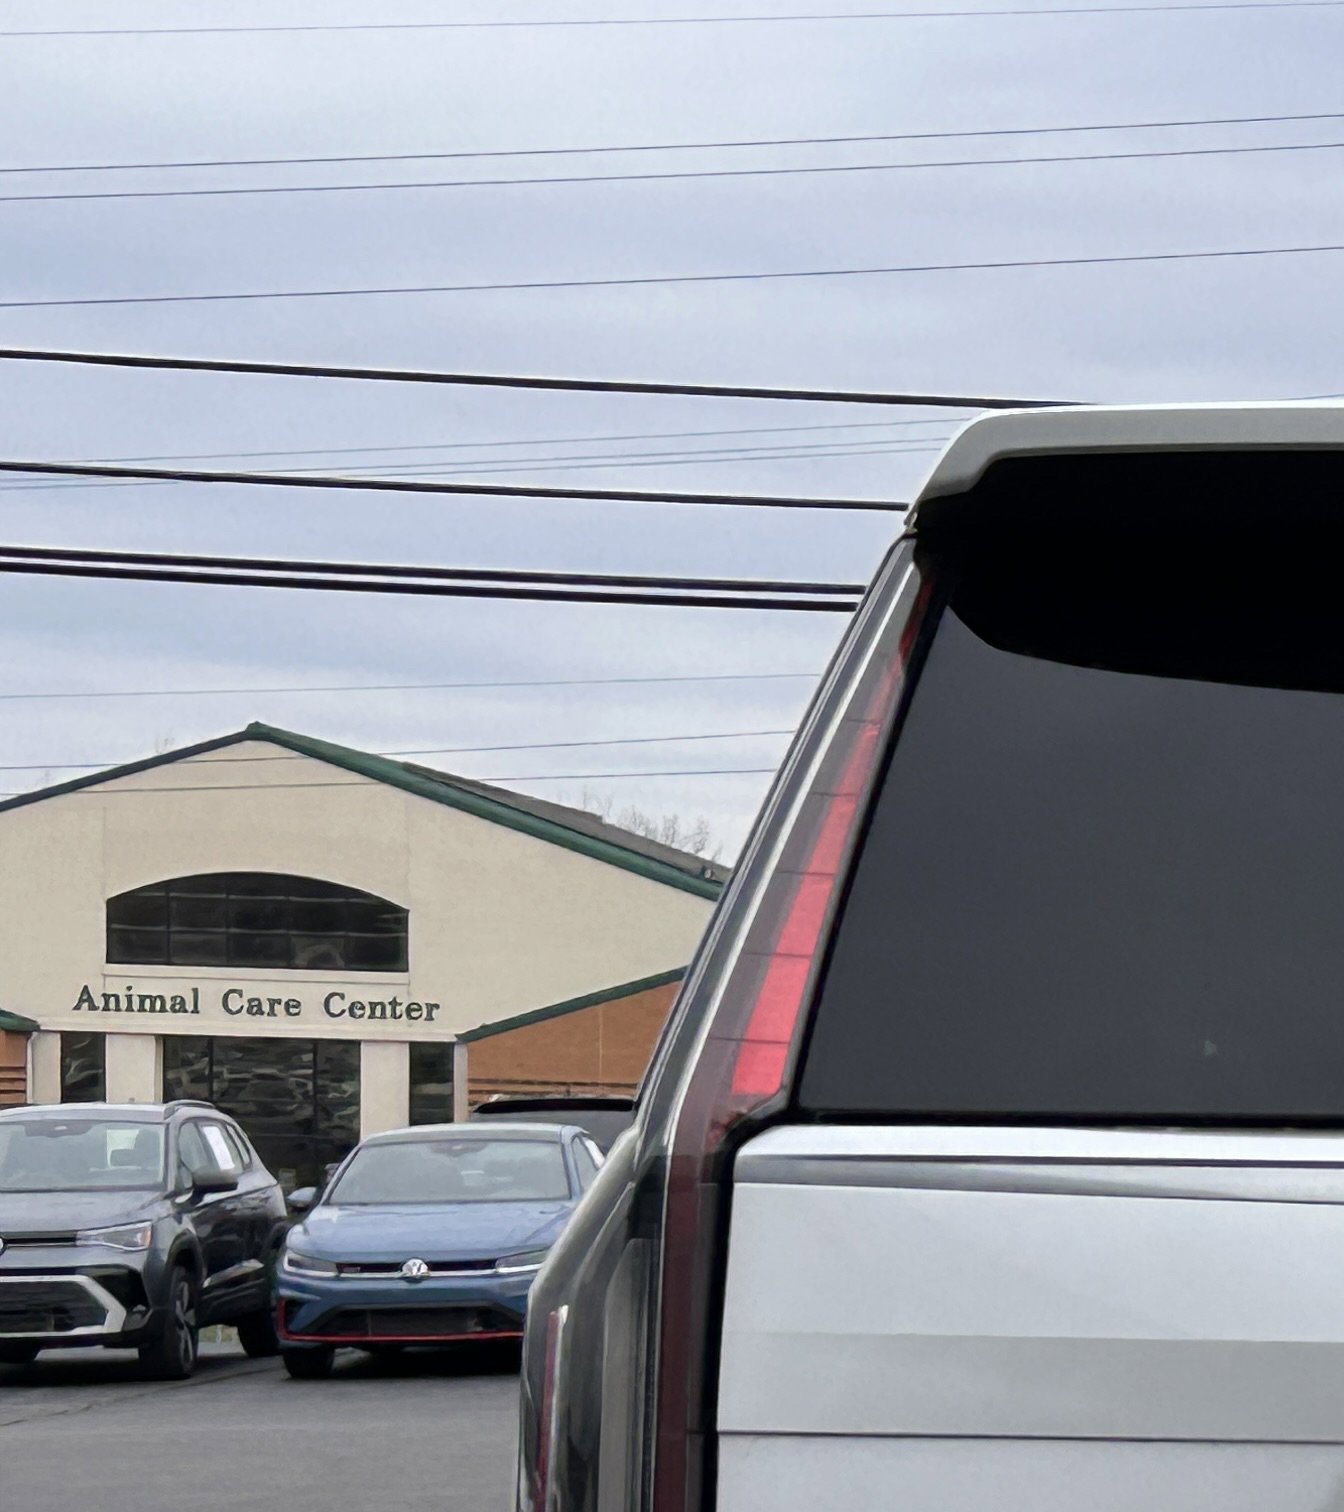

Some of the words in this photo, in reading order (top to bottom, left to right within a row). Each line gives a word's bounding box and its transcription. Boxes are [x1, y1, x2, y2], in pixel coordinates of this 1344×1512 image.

[72, 984, 200, 1014] Animal
[221, 988, 302, 1017] Care
[323, 992, 440, 1021] Center
